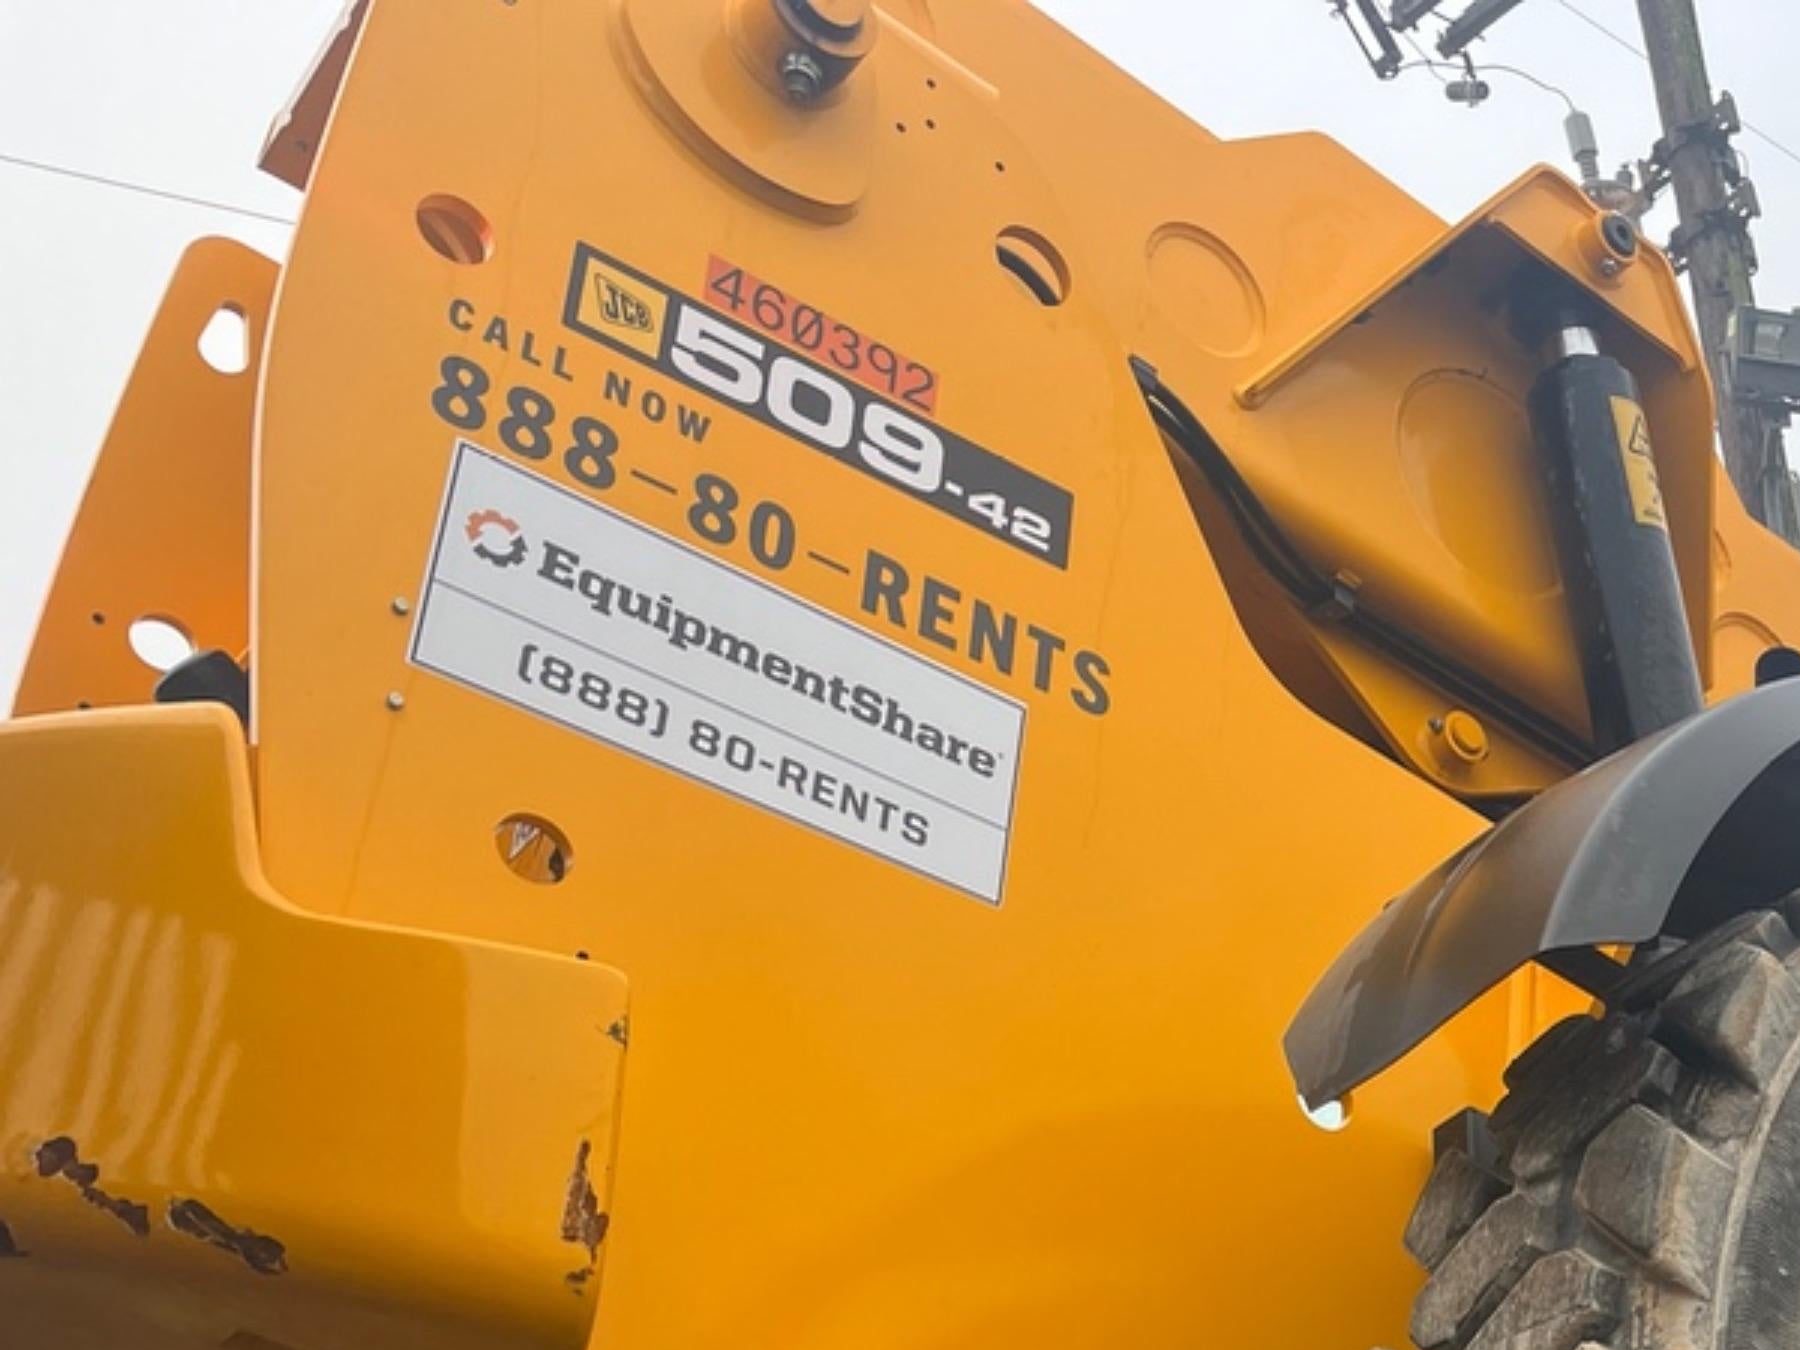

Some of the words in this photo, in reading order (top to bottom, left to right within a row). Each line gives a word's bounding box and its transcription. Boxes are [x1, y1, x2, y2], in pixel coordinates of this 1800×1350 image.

[447, 298, 574, 382] CALL
[604, 374, 712, 444] NOW
[669, 302, 1053, 556] 509-42
[707, 264, 937, 412] 460392
[430, 354, 1114, 717] 888-80-RENTS
[517, 642, 670, 738] (888)
[687, 719, 930, 848] 80-RENTS
[536, 539, 998, 779] EquipmentShare
